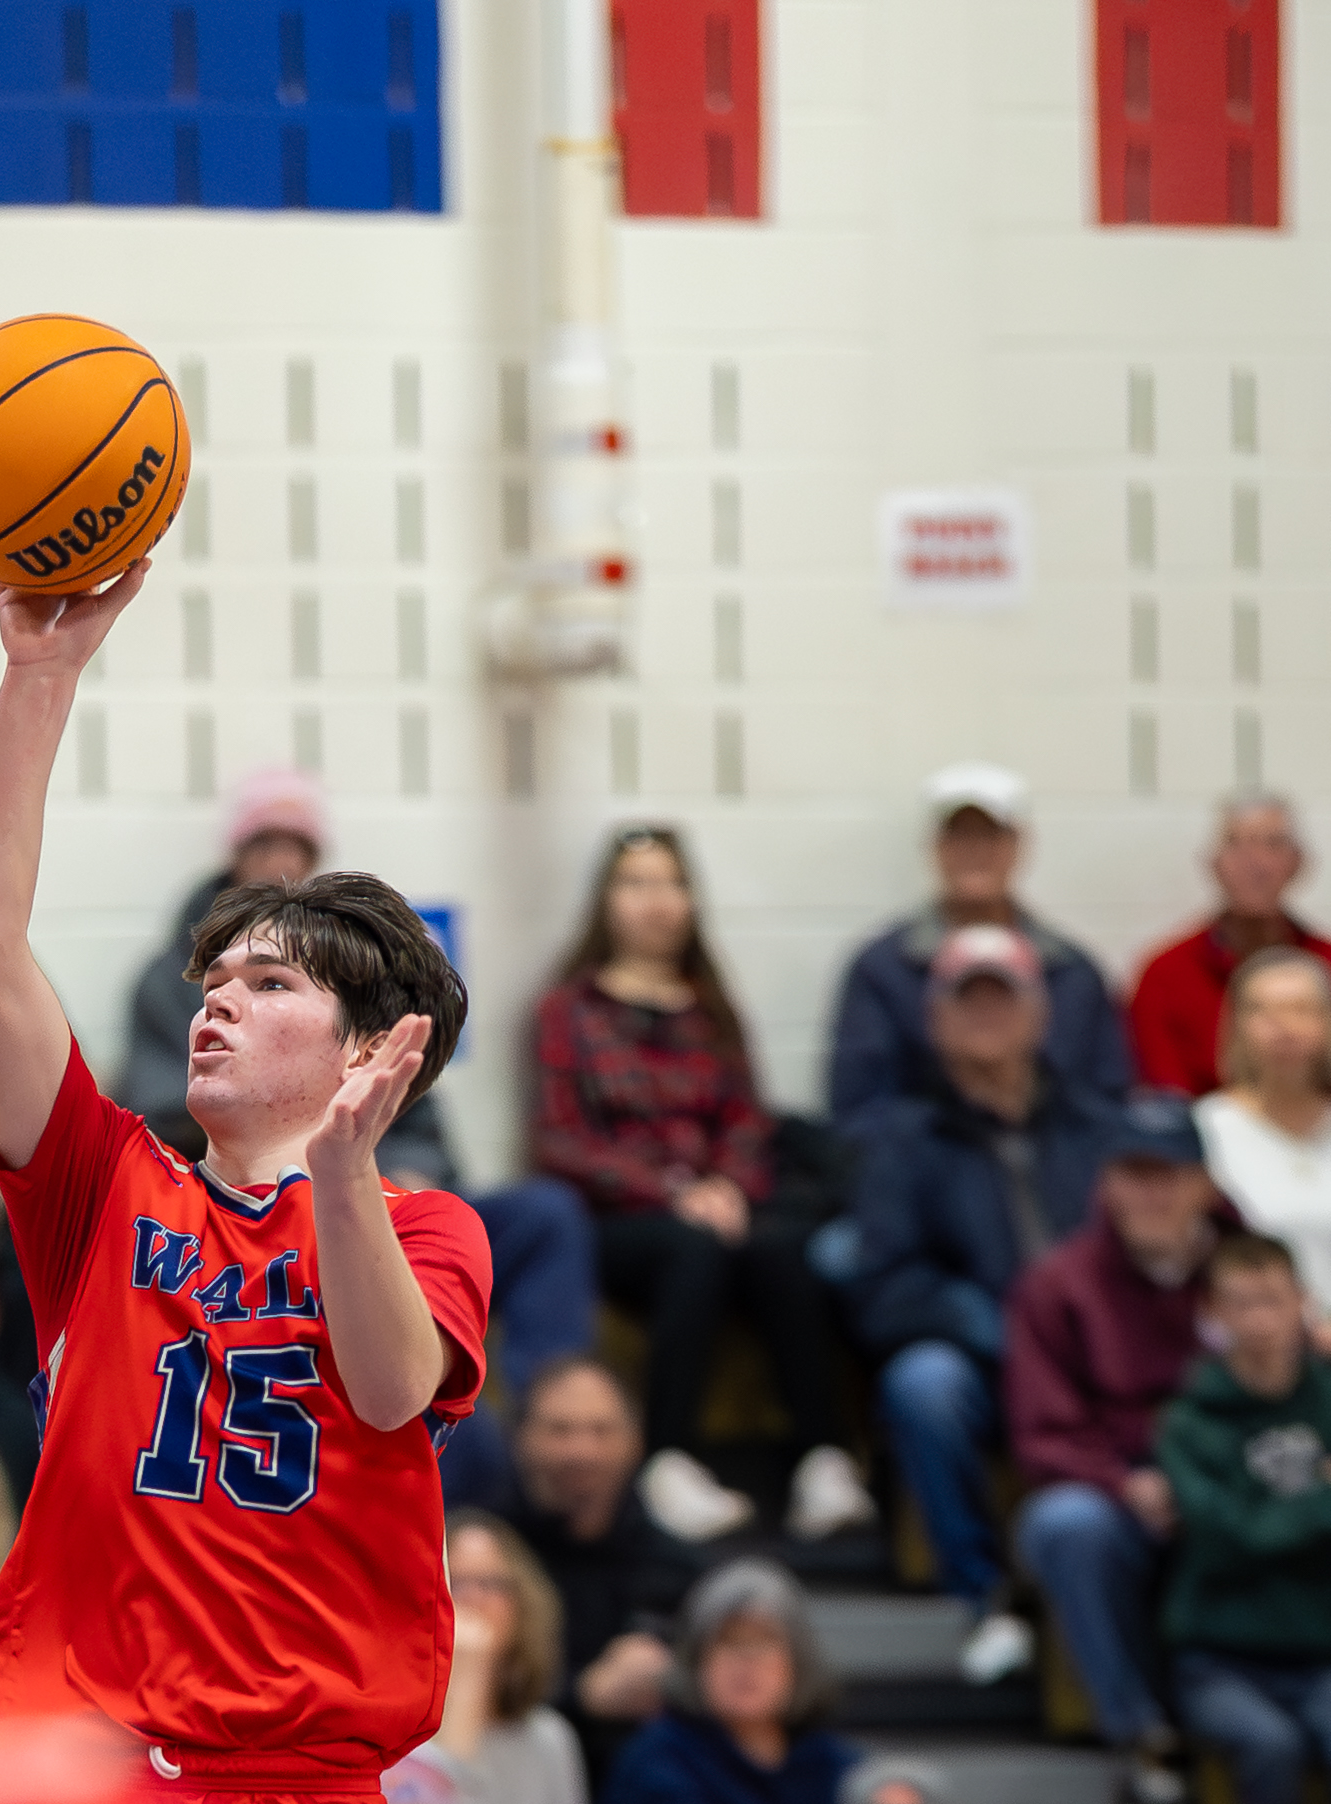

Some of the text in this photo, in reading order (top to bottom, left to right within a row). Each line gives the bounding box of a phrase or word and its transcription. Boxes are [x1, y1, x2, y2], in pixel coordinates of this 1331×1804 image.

[5, 445, 166, 578] Wilson
[131, 1215, 327, 1324] WAL
[132, 1328, 323, 1512] 15
